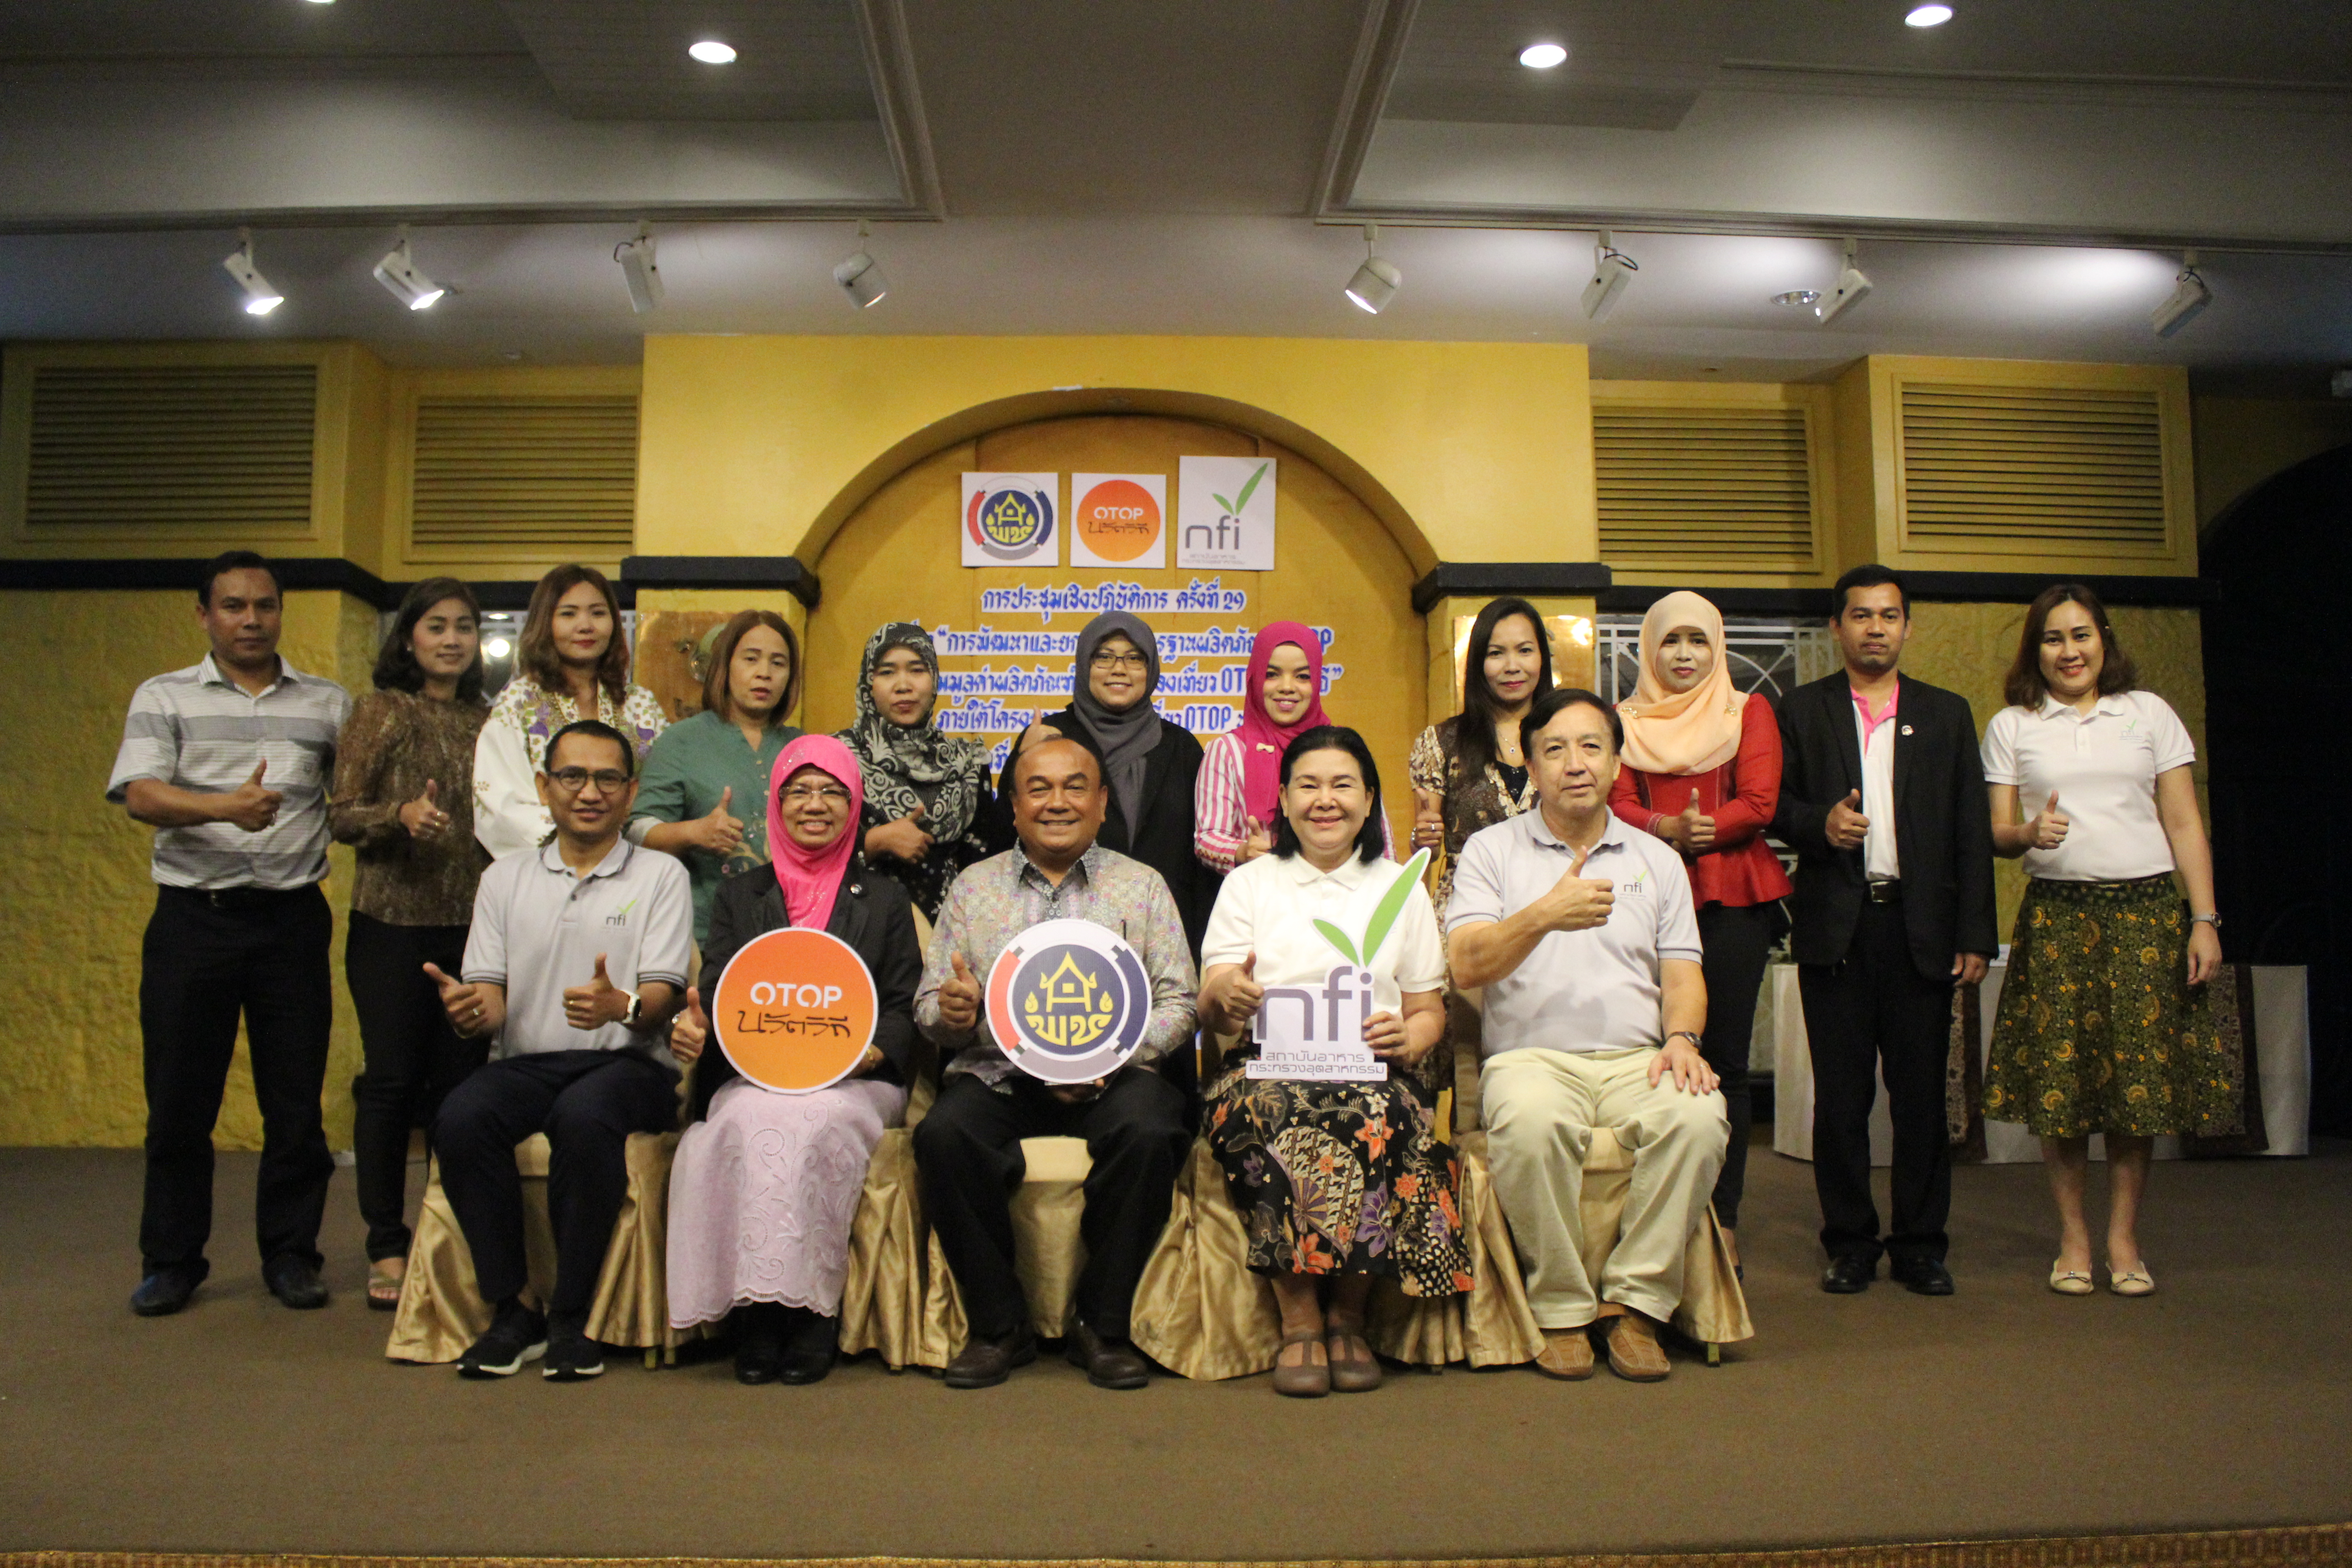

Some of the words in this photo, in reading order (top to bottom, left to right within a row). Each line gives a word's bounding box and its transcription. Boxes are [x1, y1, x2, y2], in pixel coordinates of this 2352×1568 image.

[1094, 506, 1143, 520] OTOP
[1185, 515, 1240, 549] nfi
[1176, 578, 1220, 610] ครั้งที่
[1185, 706, 1231, 731] OTOP
[1623, 882, 1642, 893] nfi
[606, 914, 626, 926] nfi
[750, 981, 843, 1009] OTOP
[1256, 966, 1372, 1042] nfi
[1265, 1050, 1365, 1063] สถาบันอาหาร
[1249, 1063, 1384, 1076] กระทรวงอุตสาหกรรม
